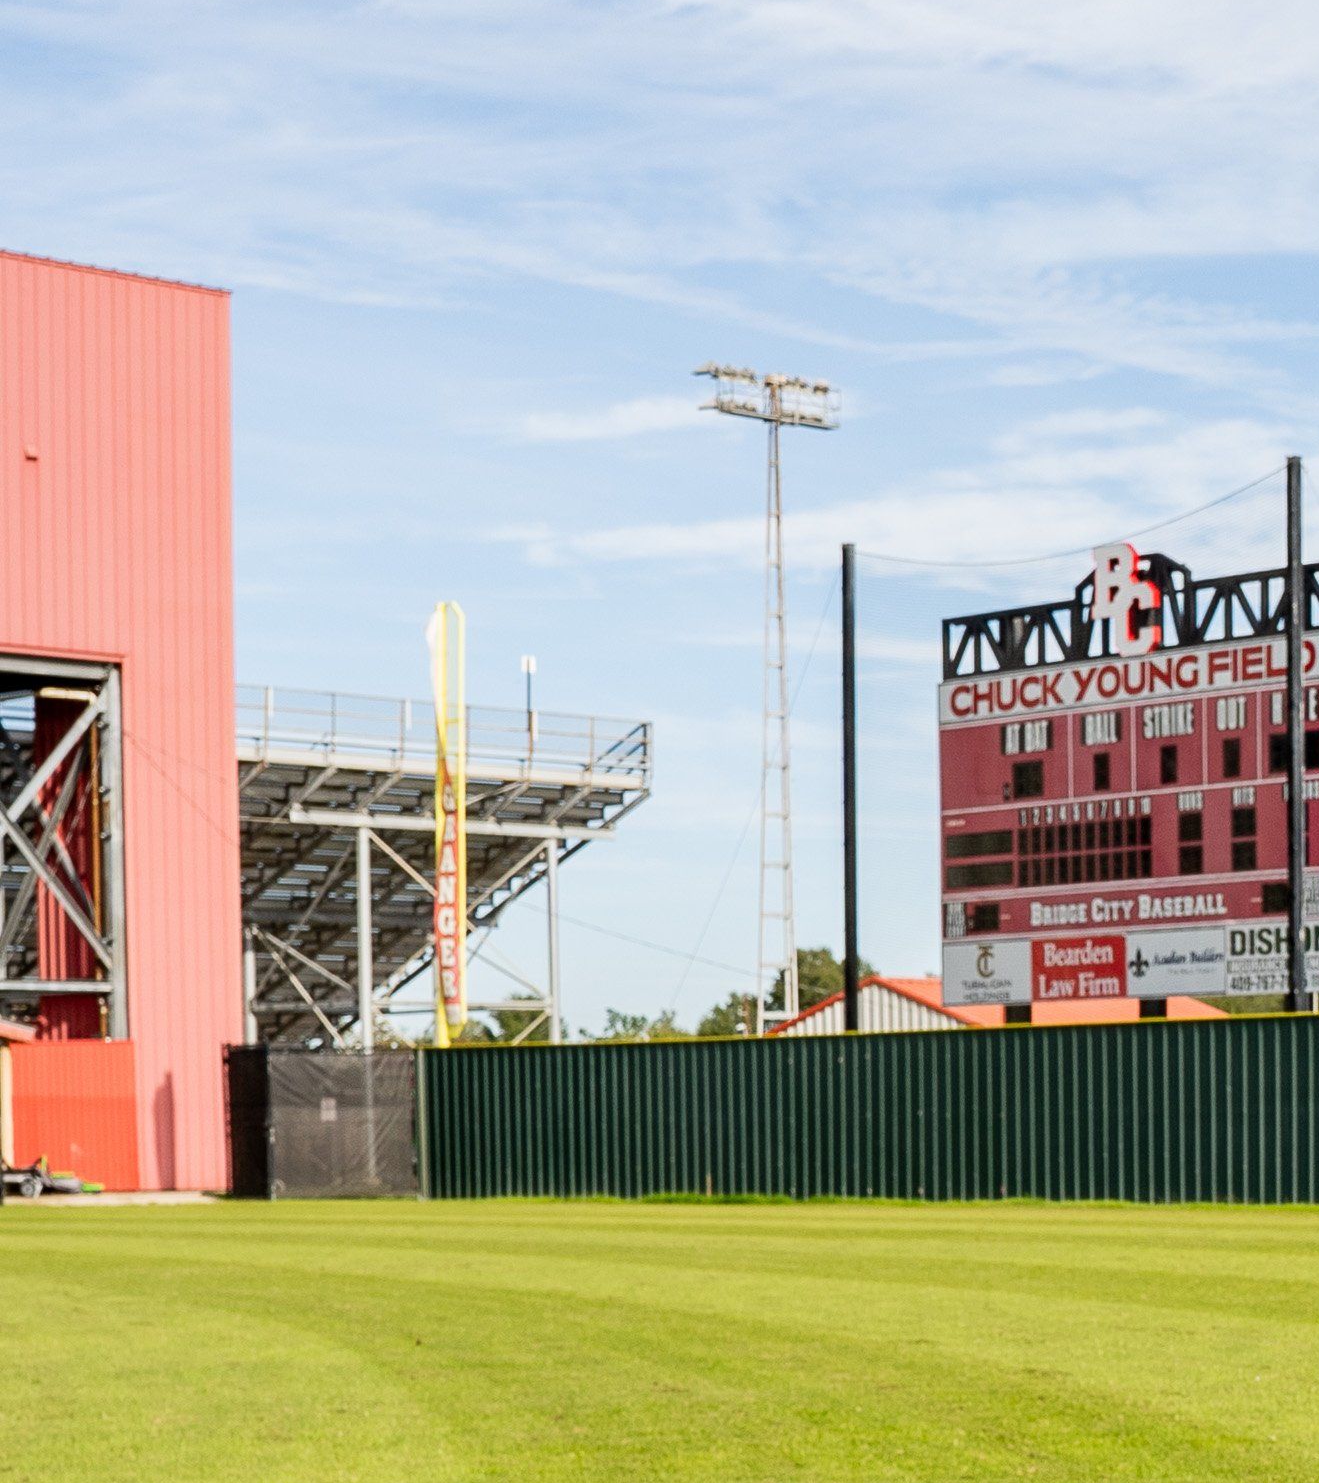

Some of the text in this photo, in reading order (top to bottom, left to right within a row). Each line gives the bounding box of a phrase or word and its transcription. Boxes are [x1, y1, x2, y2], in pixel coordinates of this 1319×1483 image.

[950, 671, 1064, 717] CHUCK
[1073, 654, 1199, 703] YOUNG
[1143, 701, 1195, 740] STRIKE
[1216, 695, 1247, 732] OUT
[1091, 897, 1135, 923] CITY
[1138, 892, 1228, 919] BASEBALL
[1043, 939, 1114, 967] Bearden
[1038, 974, 1074, 998] Law
[1078, 971, 1120, 998] Firm
